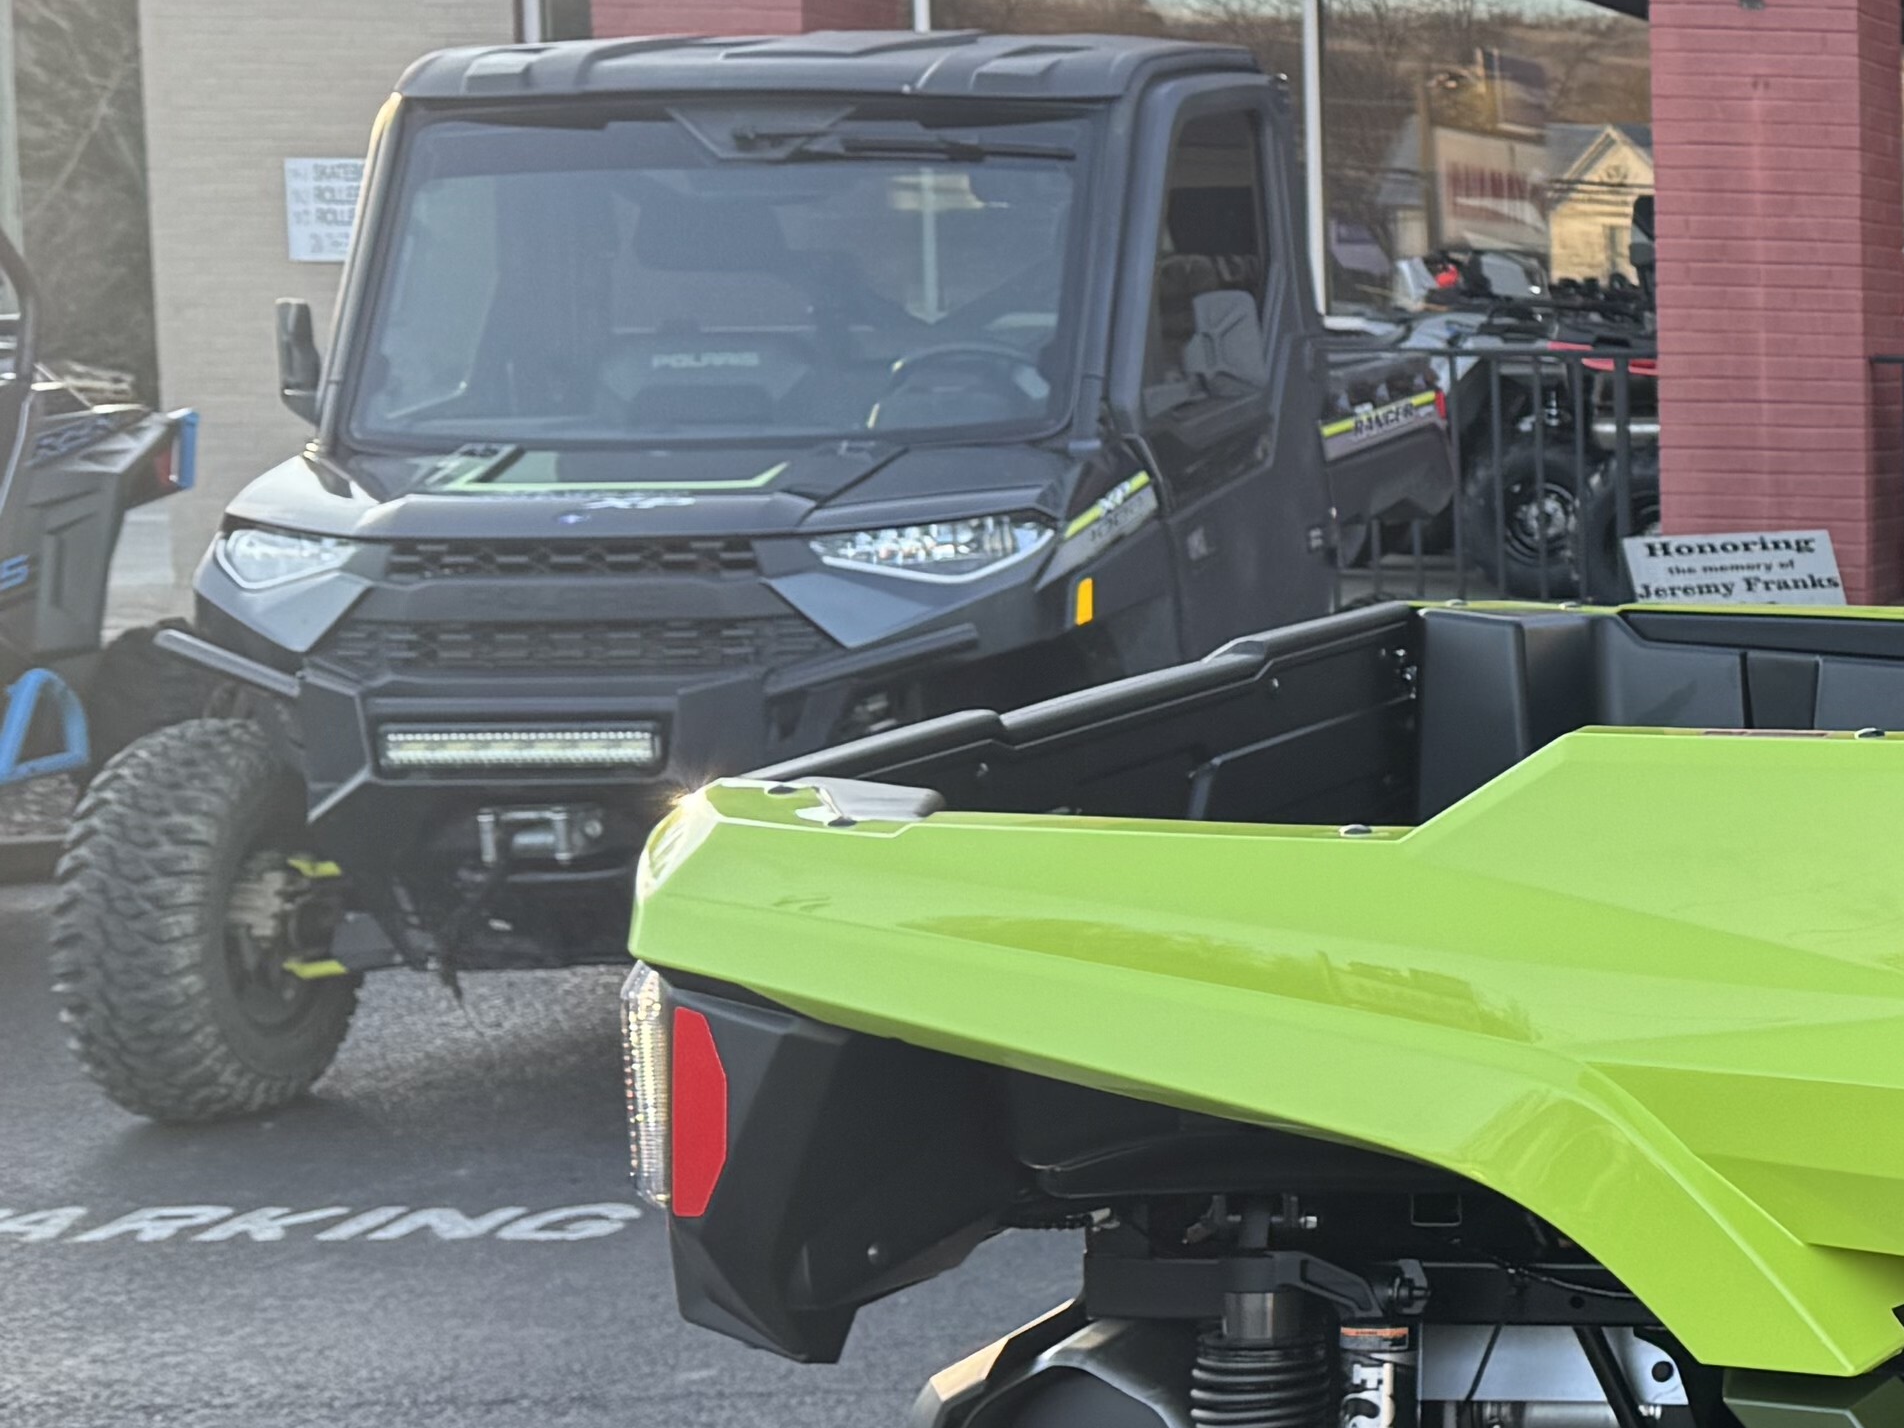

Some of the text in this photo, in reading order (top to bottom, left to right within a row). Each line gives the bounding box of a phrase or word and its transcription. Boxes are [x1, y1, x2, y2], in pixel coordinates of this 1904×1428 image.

[1643, 534, 1816, 559] Honoring
[1667, 564, 1697, 576] the
[1701, 560, 1774, 575] memory
[1637, 572, 1841, 600] Jeremy Franks
[0, 1203, 642, 1242] ARKING
